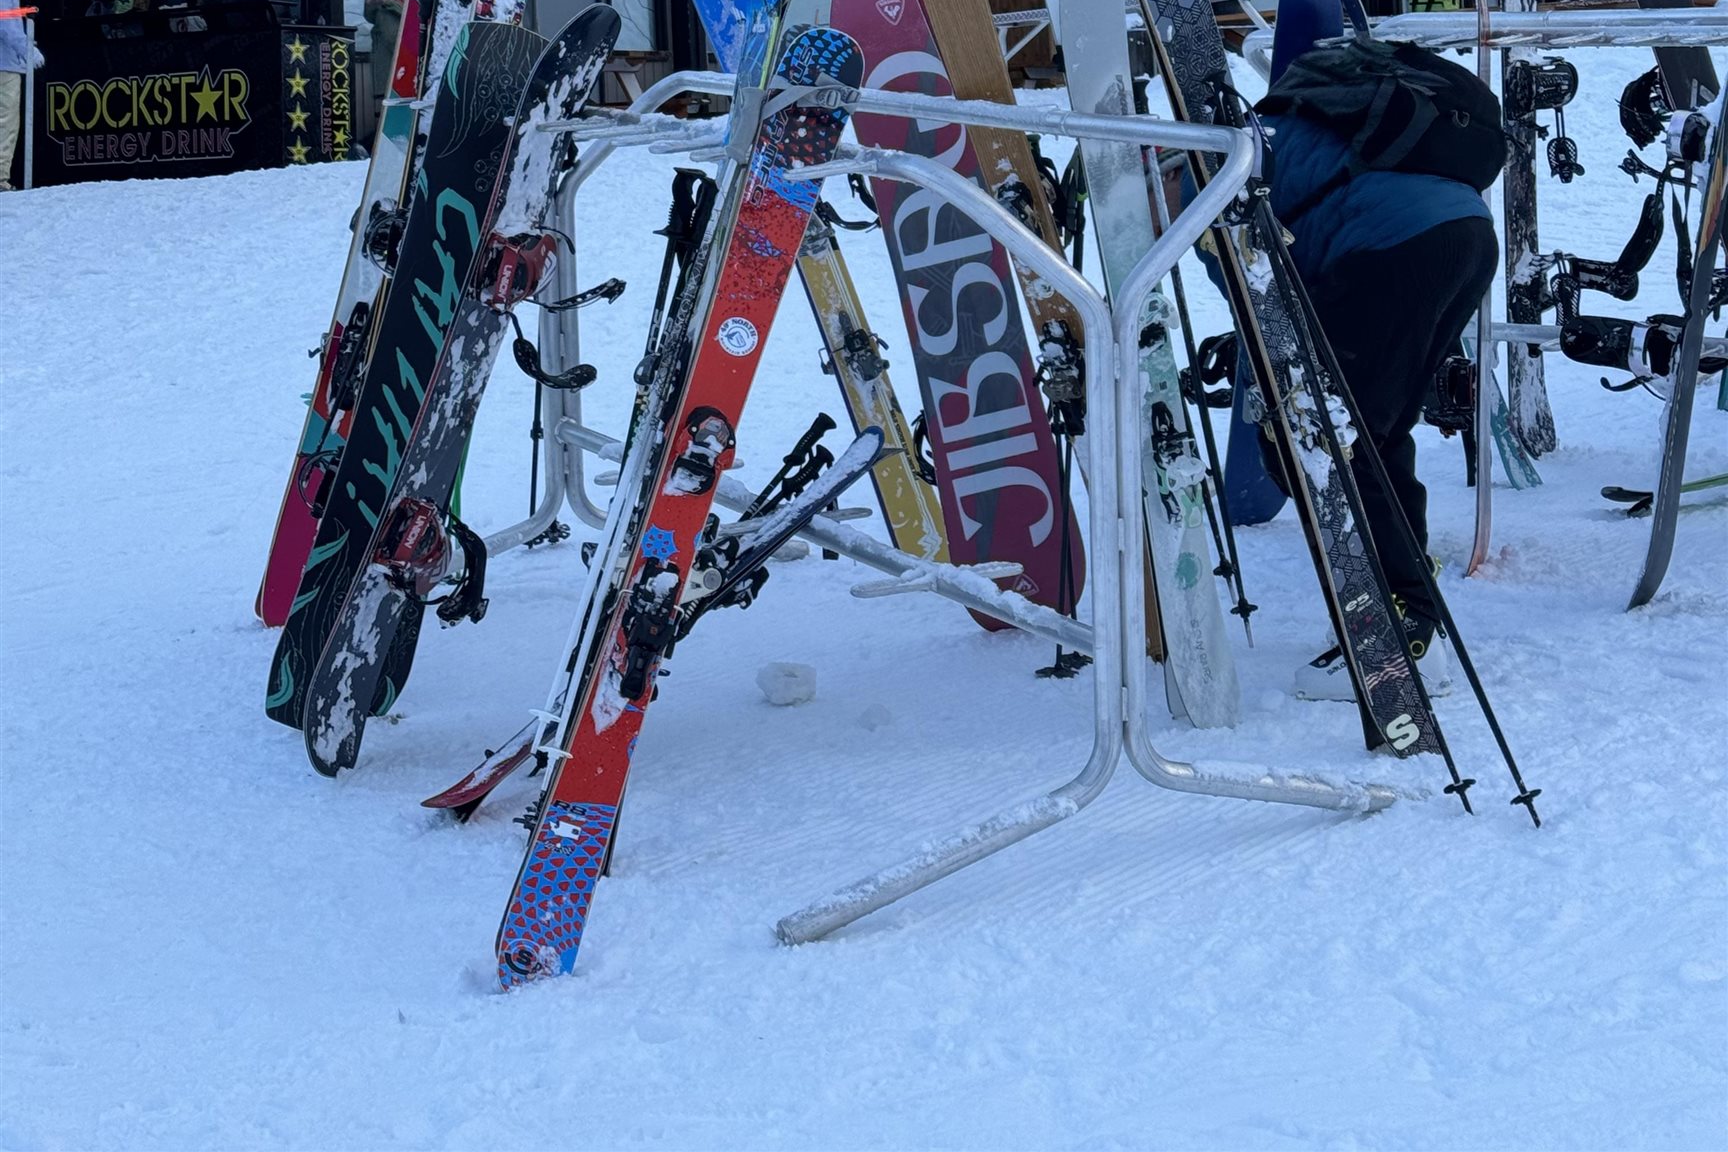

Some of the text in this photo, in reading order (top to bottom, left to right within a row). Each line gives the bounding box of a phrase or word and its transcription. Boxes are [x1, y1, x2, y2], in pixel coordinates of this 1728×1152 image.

[322, 43, 333, 152] ENERGY DRINK
[64, 127, 231, 161] ENERGY DRINK
[498, 264, 513, 302] UNION
[404, 515, 427, 549] UNION
[1386, 713, 1420, 751] S
[553, 800, 587, 816] R8
